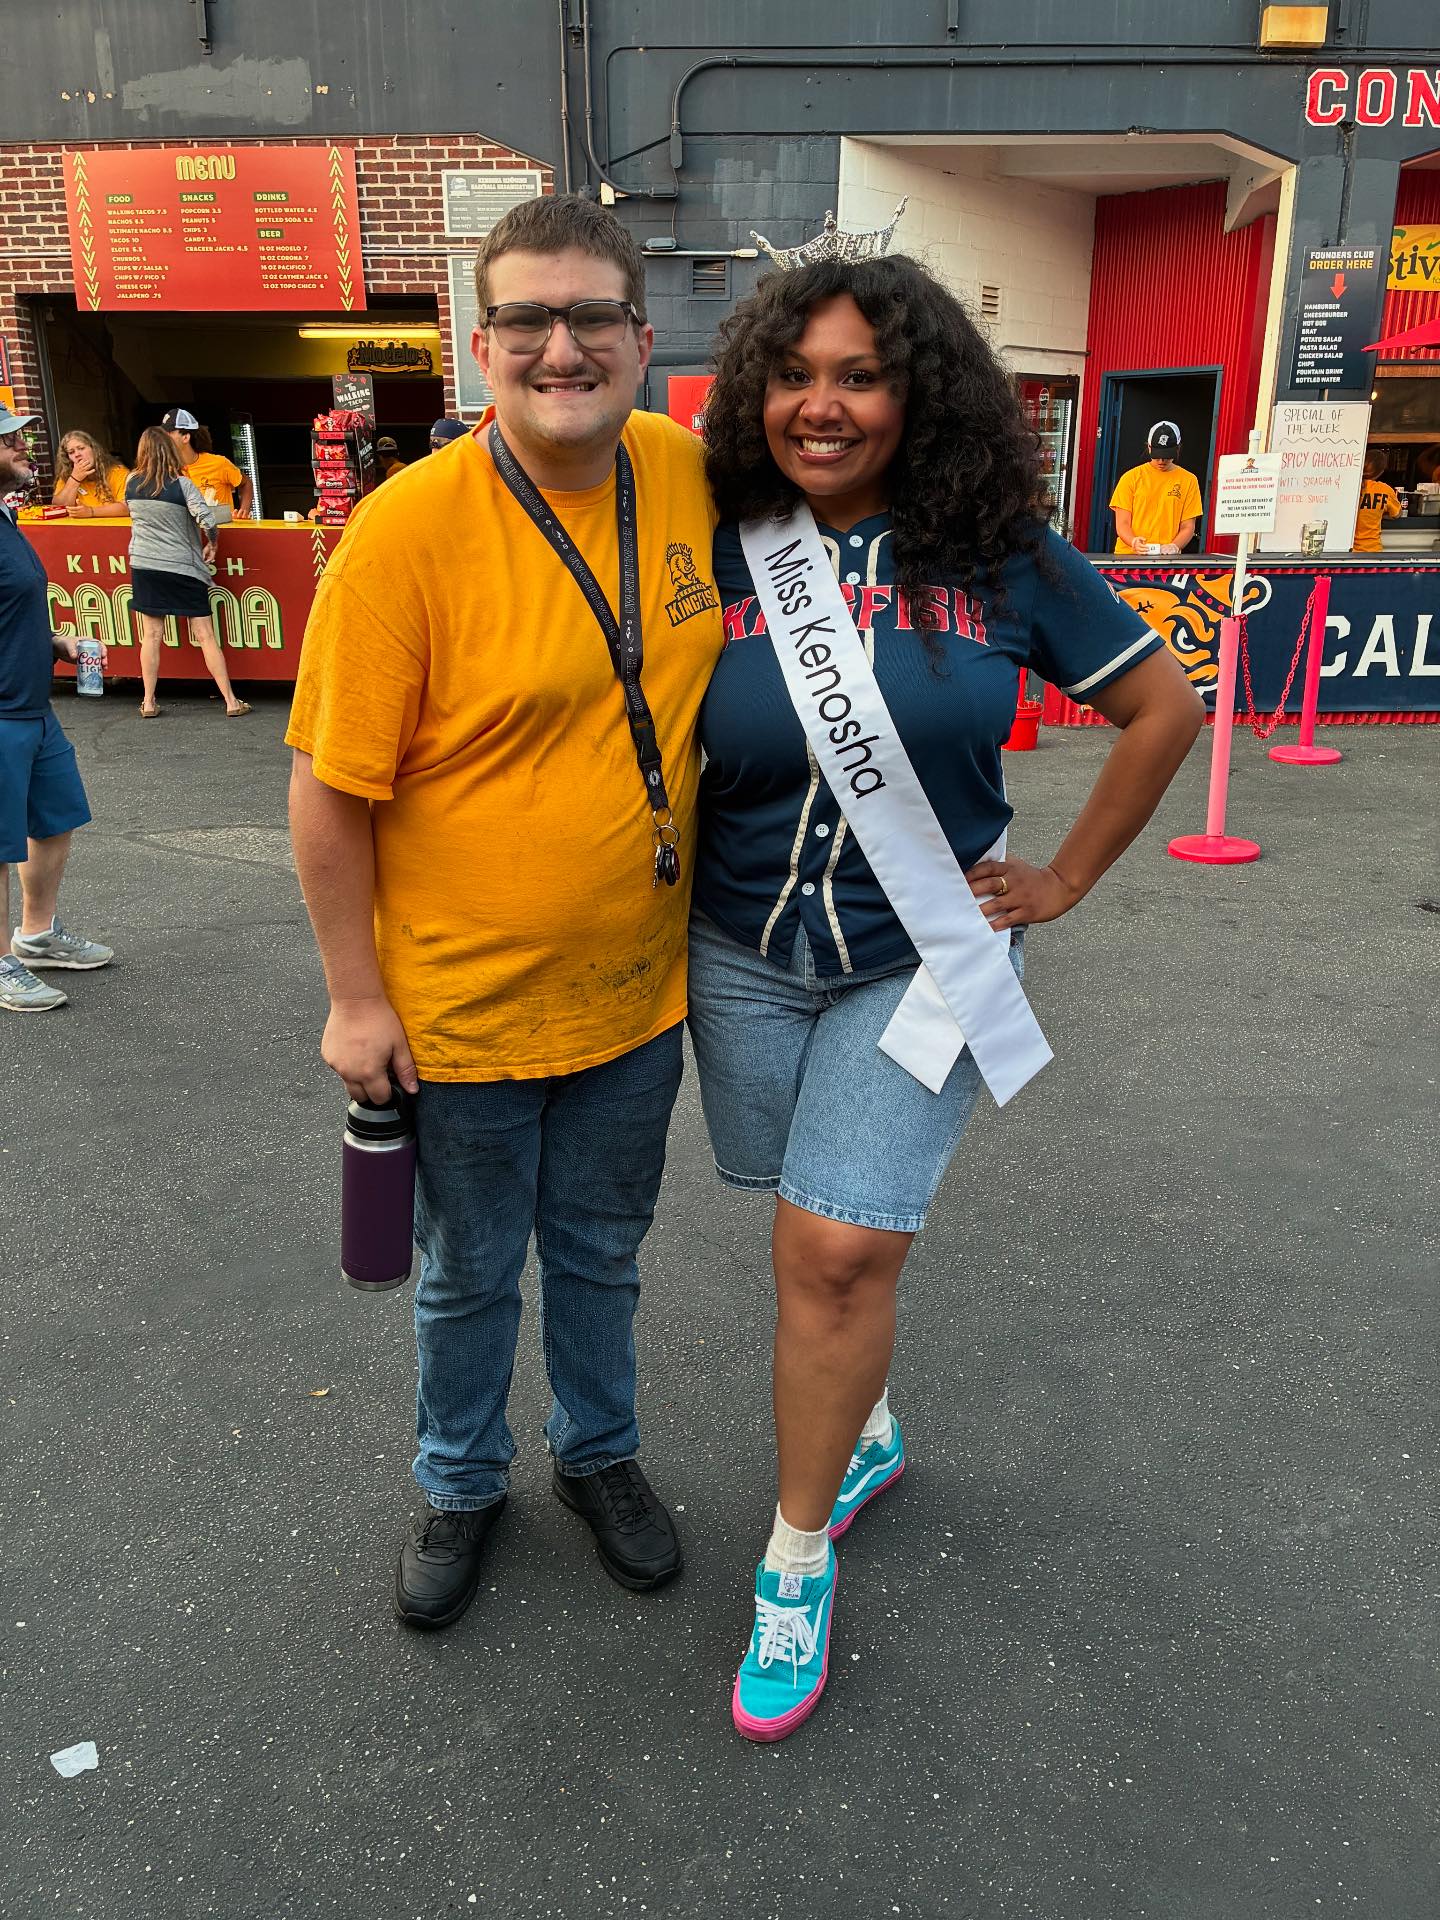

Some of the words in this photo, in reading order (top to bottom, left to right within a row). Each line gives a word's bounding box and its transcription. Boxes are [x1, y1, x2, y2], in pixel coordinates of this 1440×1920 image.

[1305, 69, 1440, 127] CON
[176, 155, 236, 180] MENU
[1311, 251, 1352, 260] FOUNDERS
[1354, 251, 1375, 259] CLUB
[1310, 261, 1343, 270] ORDER
[1346, 260, 1373, 269] HERE
[358, 341, 418, 363] Modelo
[337, 388, 371, 403] WALKING
[348, 398, 363, 407] TACO
[1284, 409, 1324, 422] SPECIAL
[1331, 409, 1344, 420] OF
[1287, 424, 1307, 435] THE
[1310, 424, 1340, 433] WEEK
[1281, 452, 1309, 469] SPICY
[1312, 452, 1354, 468] CHICKEN
[1280, 495, 1303, 504] CHEESE
[1360, 493, 1388, 509] AFF
[764, 539, 814, 616] Miss
[46, 581, 282, 648] CANNA
[1320, 614, 1440, 676] CAL
[78, 651, 101, 665] Coo
[789, 615, 886, 800] Kenosha
